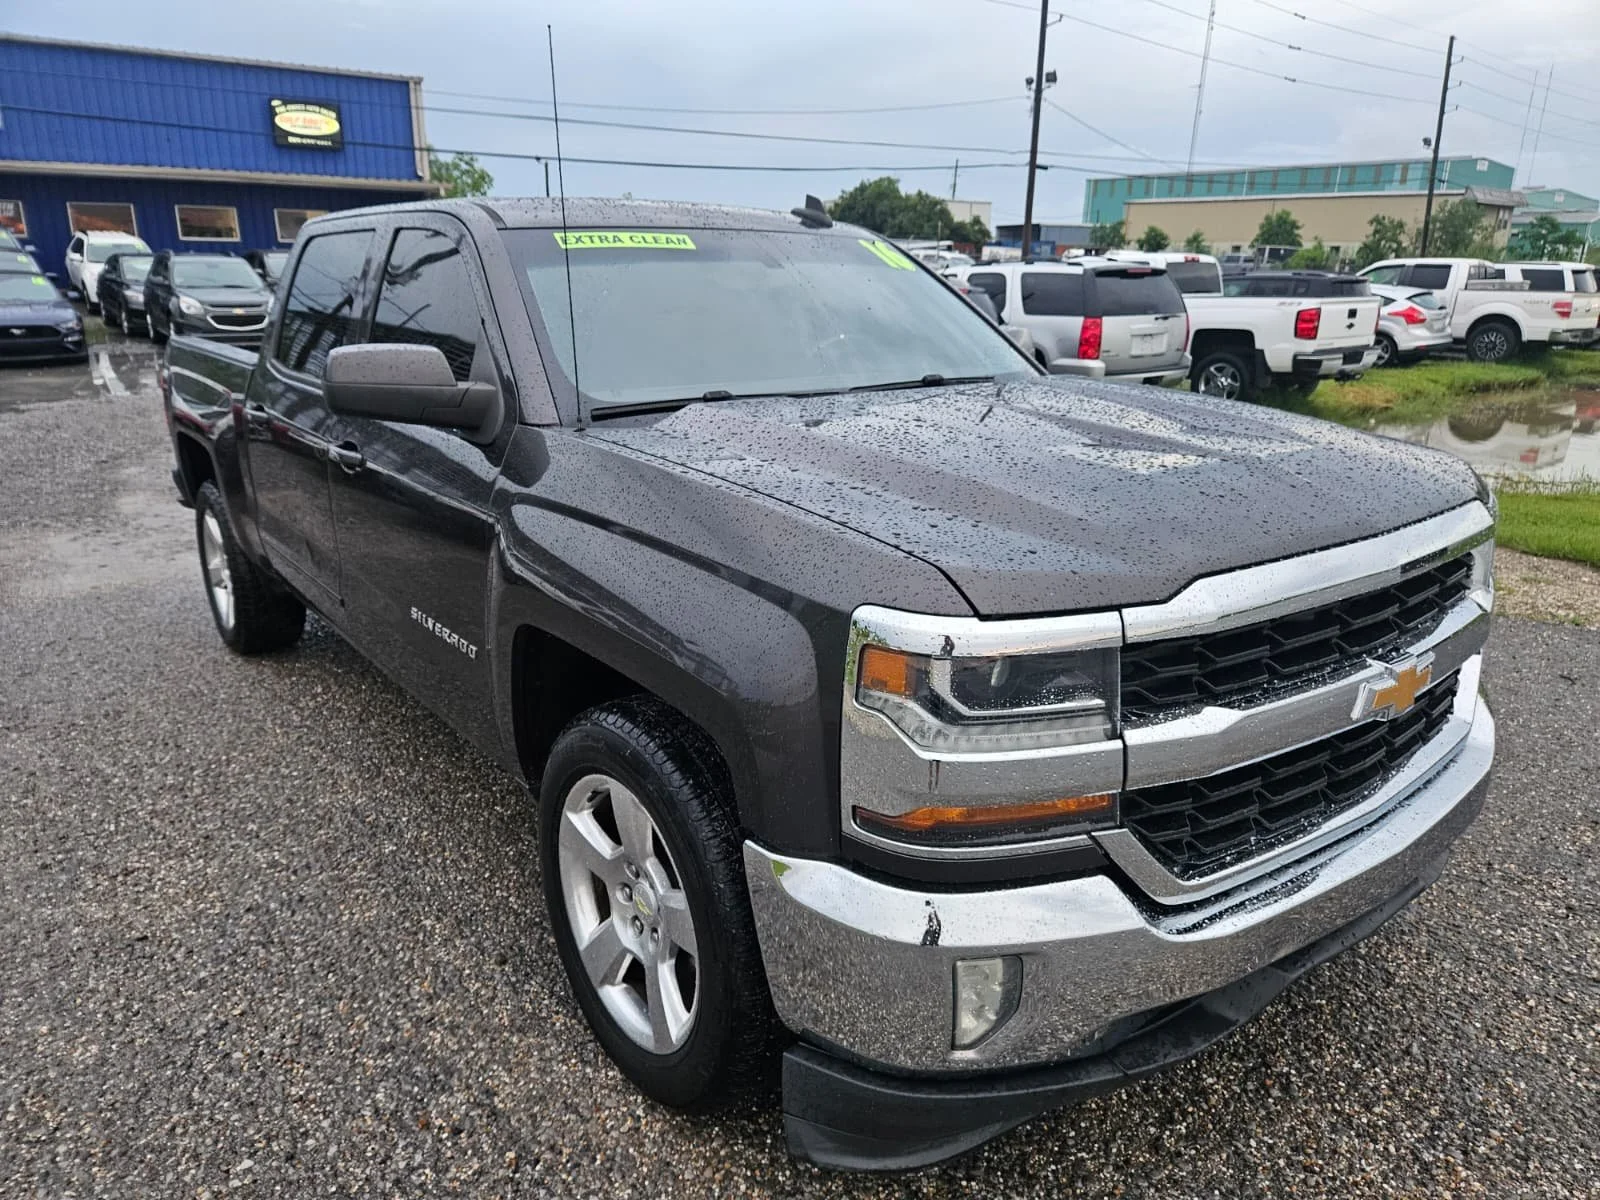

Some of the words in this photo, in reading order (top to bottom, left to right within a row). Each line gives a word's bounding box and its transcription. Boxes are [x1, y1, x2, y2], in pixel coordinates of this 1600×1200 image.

[560, 234, 621, 245] EXTRA
[629, 235, 688, 246] CLEAN
[410, 606, 478, 659] SILVERADO
